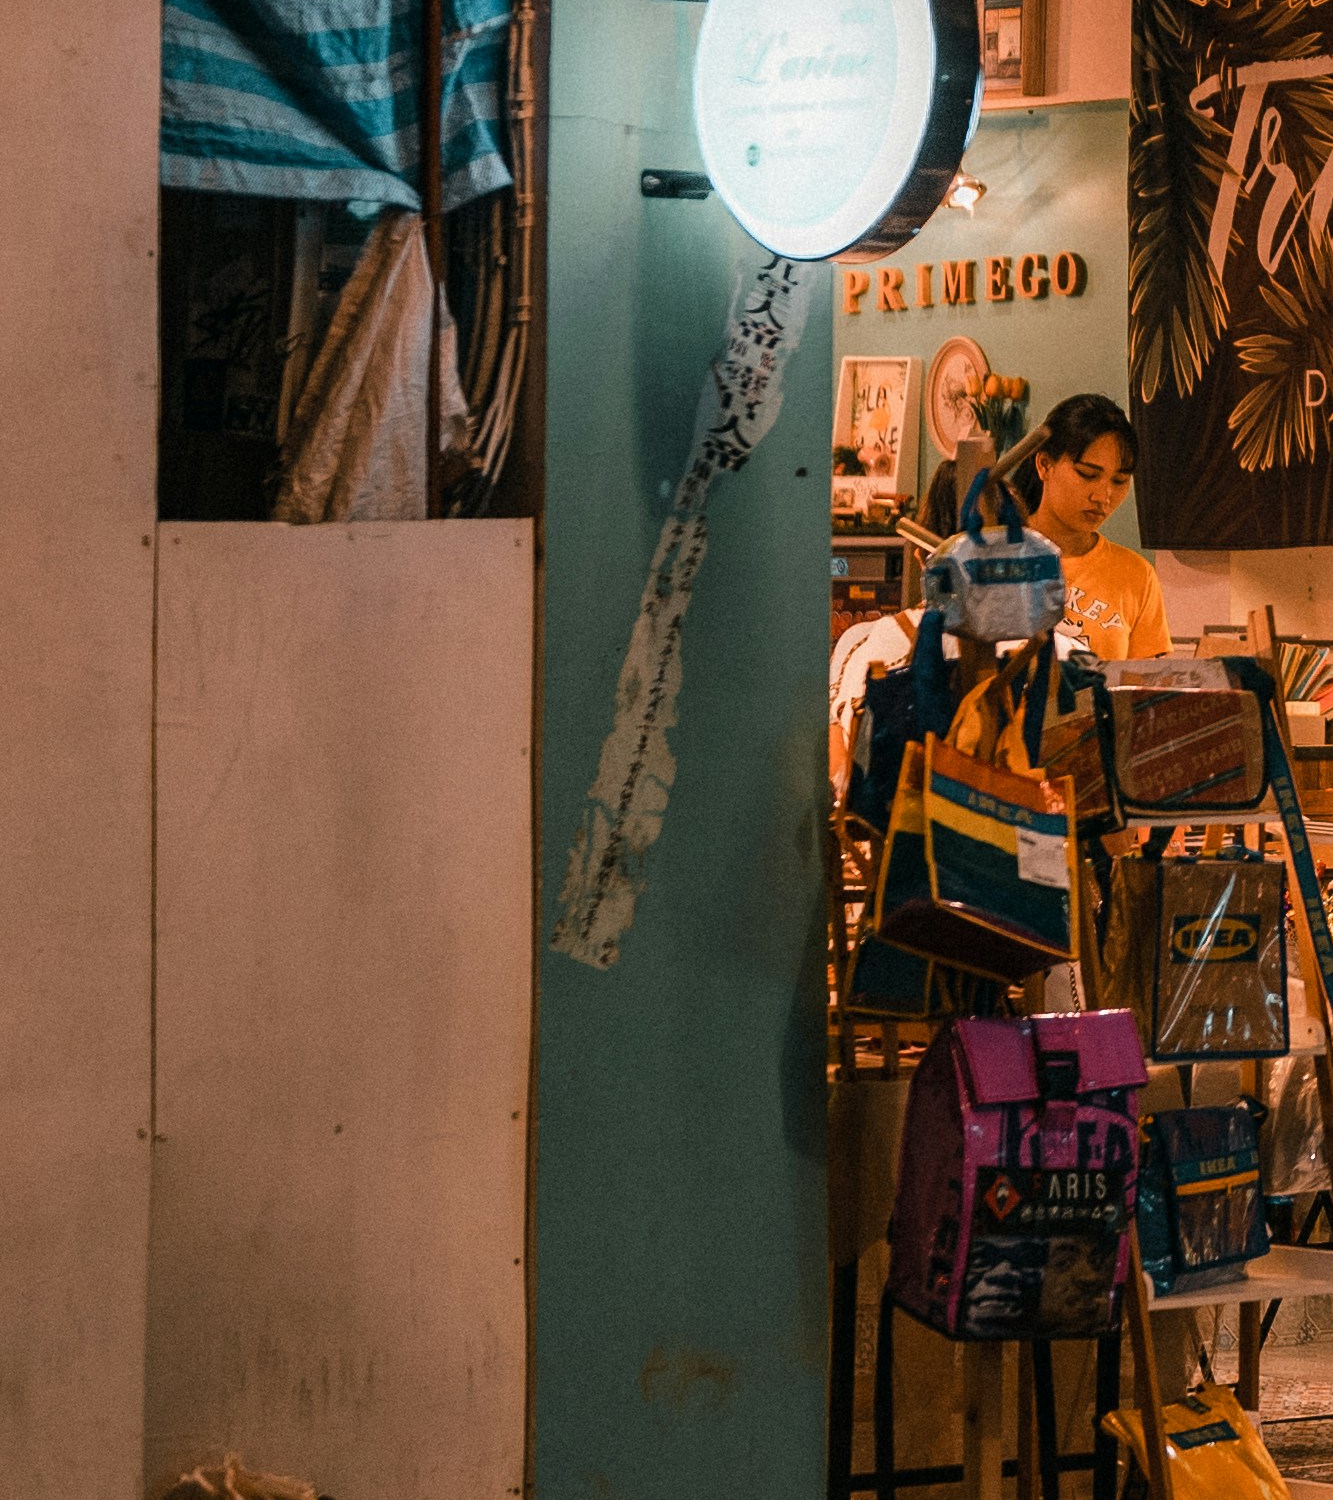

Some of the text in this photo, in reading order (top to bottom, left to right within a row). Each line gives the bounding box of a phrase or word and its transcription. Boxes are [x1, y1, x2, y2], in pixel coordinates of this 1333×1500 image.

[842, 250, 1081, 315] PRIMEGO
[1064, 586, 1124, 630] KEY
[1181, 928, 1251, 949] IKEA
